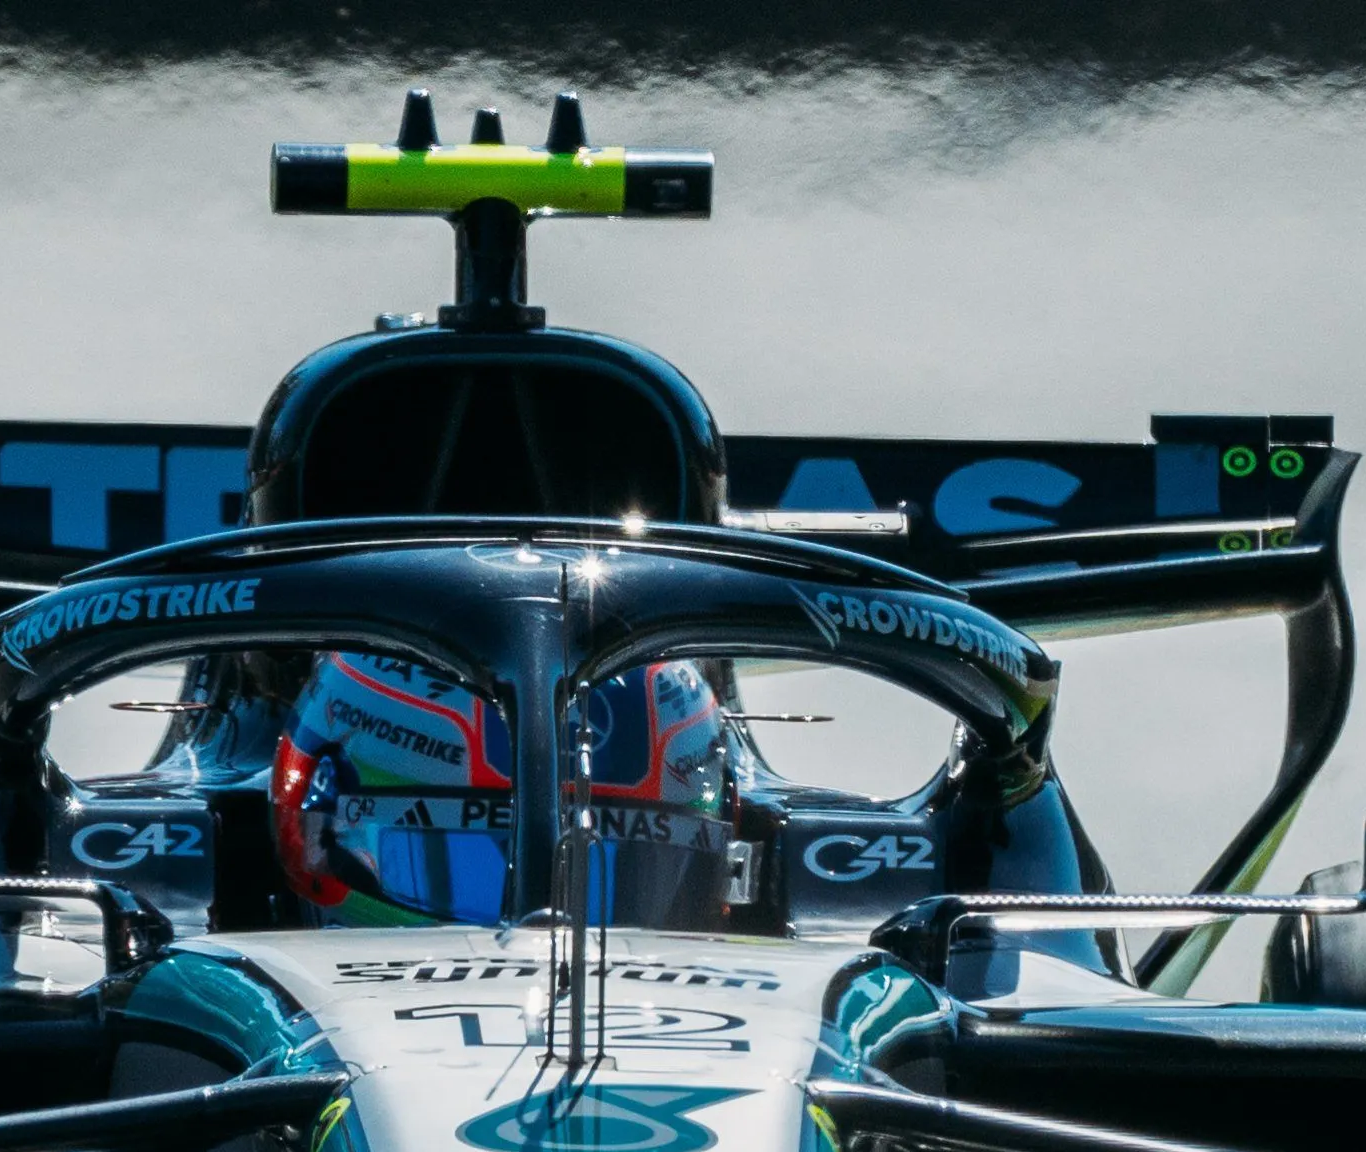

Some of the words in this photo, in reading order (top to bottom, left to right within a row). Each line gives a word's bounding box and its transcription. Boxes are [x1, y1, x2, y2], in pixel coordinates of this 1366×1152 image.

[11, 578, 262, 651] CROWDSTRIKE
[816, 591, 1029, 687] CROWDSTRIKE
[330, 699, 467, 766] CROWDSTRIKE
[70, 822, 204, 870] G42
[803, 834, 935, 882] G42
[394, 1004, 751, 1052] 12
